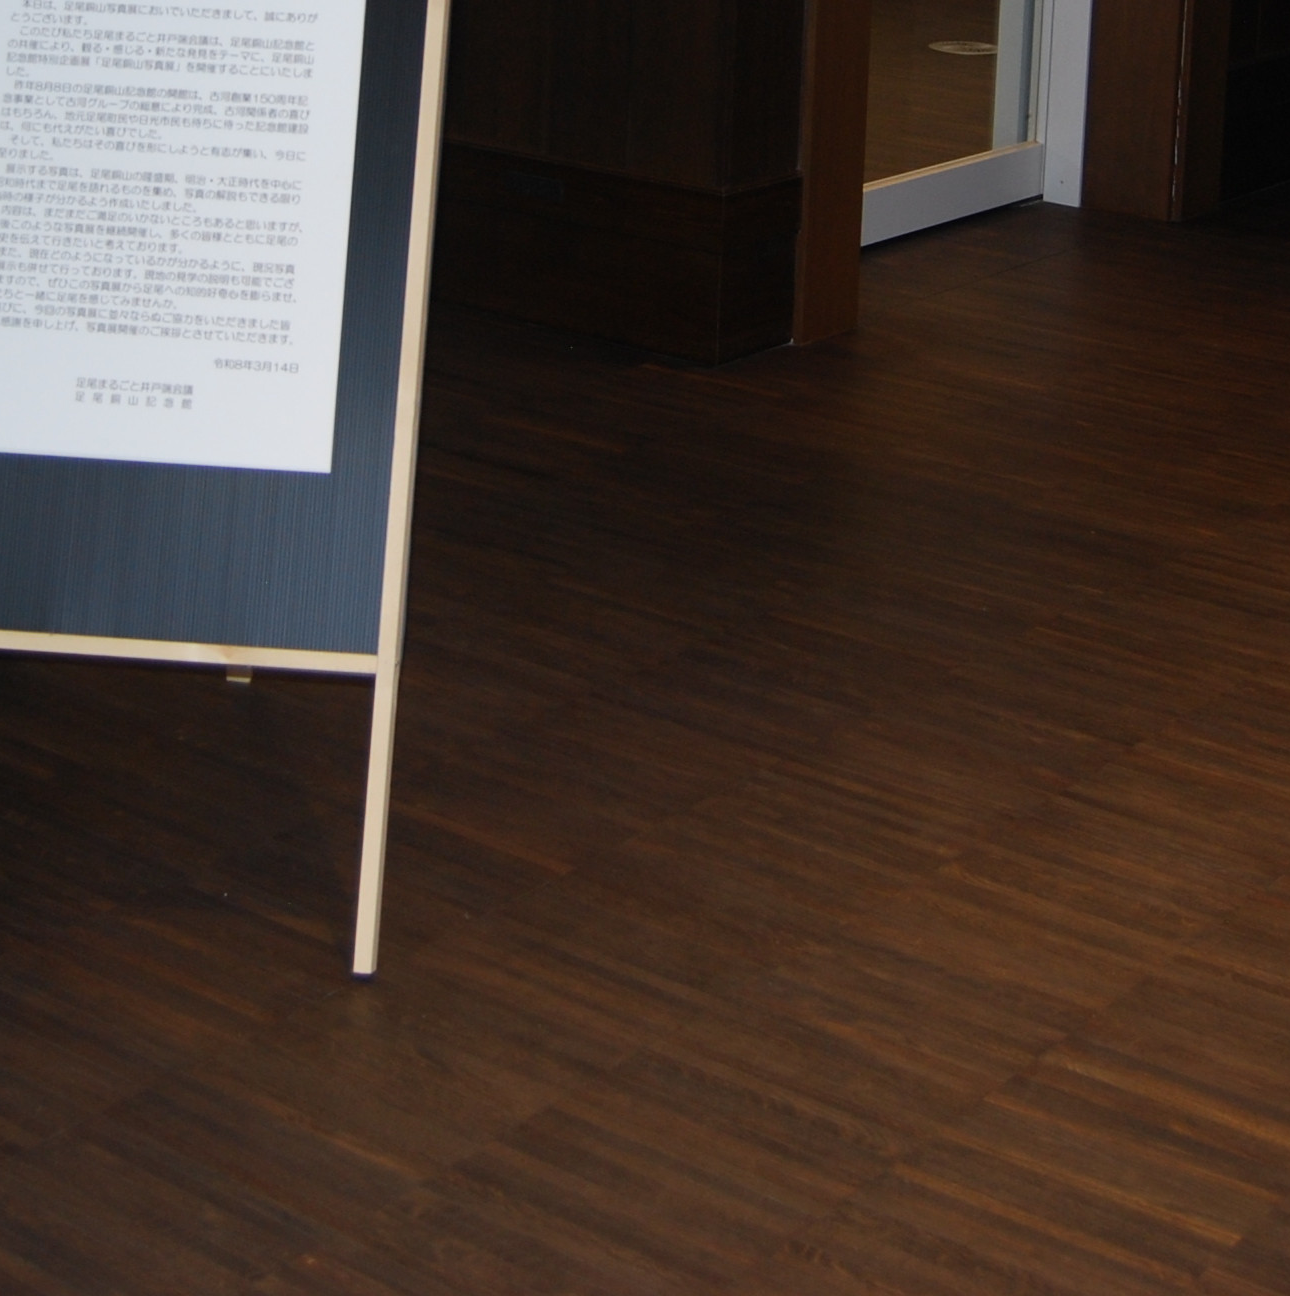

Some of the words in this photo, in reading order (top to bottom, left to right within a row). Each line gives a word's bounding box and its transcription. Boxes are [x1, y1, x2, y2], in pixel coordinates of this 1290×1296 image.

[10, 12, 87, 26] とうございます。
[6, 66, 30, 78] した。
